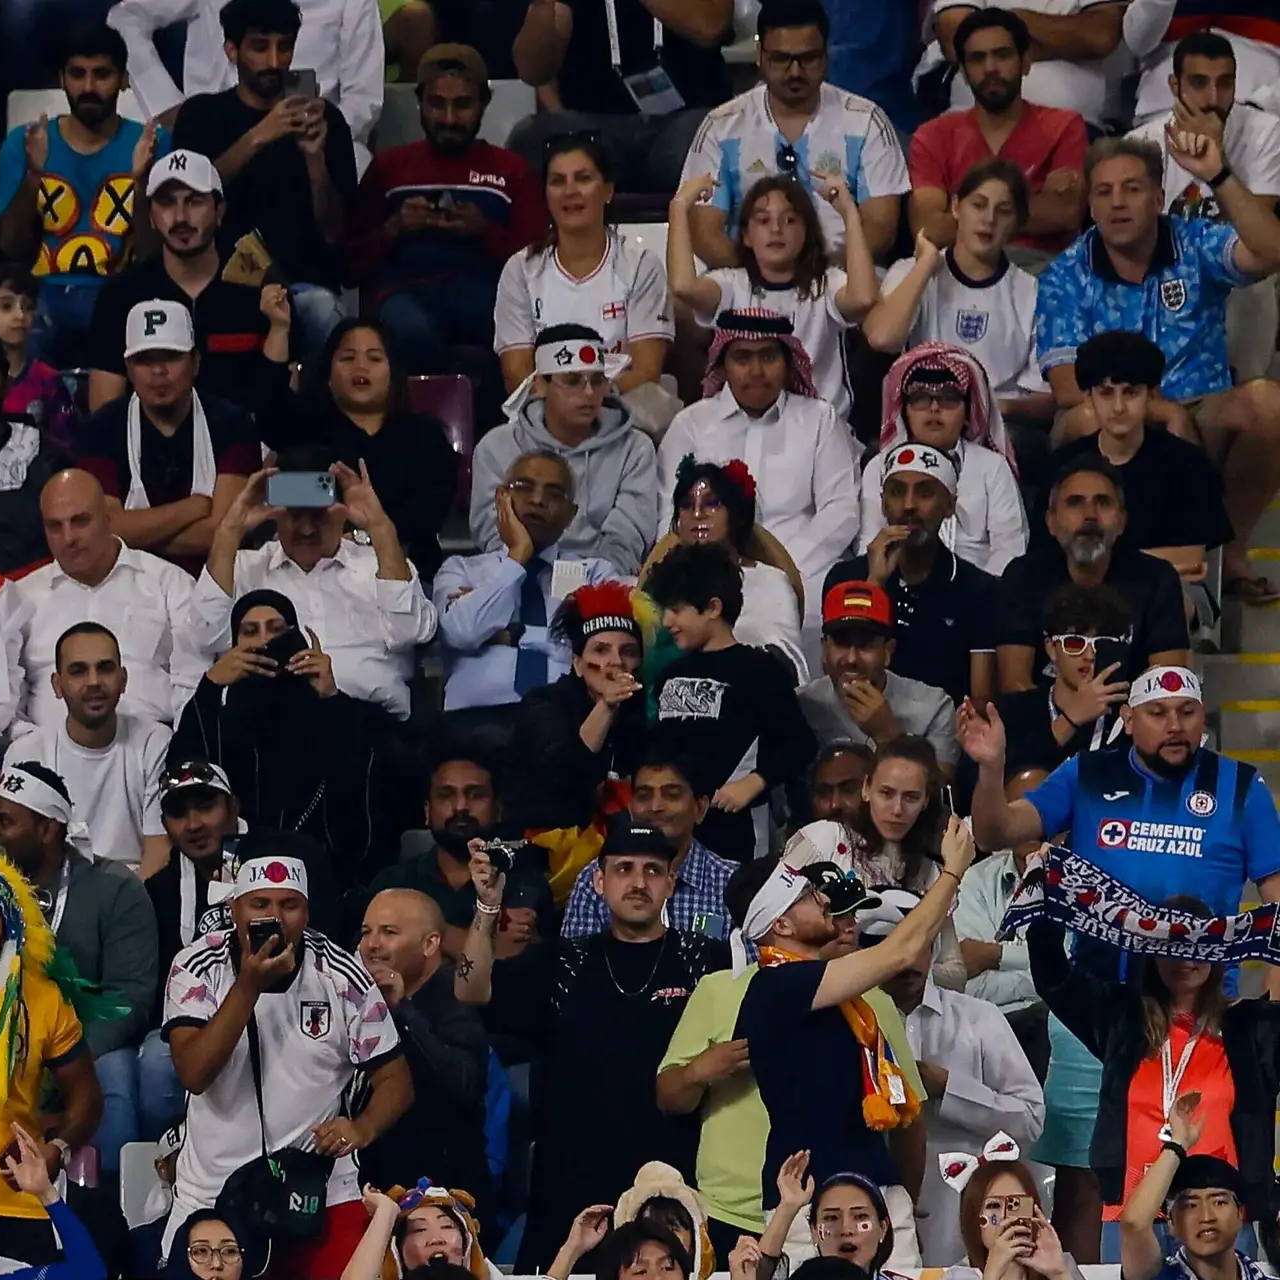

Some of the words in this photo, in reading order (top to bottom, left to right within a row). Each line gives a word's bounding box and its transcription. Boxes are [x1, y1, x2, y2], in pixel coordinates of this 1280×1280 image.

[144, 310, 167, 336] P
[583, 616, 633, 635] GERMANY
[1144, 673, 1195, 694] JAPAN
[1130, 821, 1206, 843] CEMENTO
[1127, 835, 1165, 857] CRUZ
[1166, 840, 1203, 860] AZUL
[249, 865, 301, 884] JAPAN
[1064, 855, 1113, 893] TEAM
[199, 903, 235, 934] GERM
[1073, 911, 1120, 945] BLUE
[1121, 930, 1227, 959] SAMURAI
